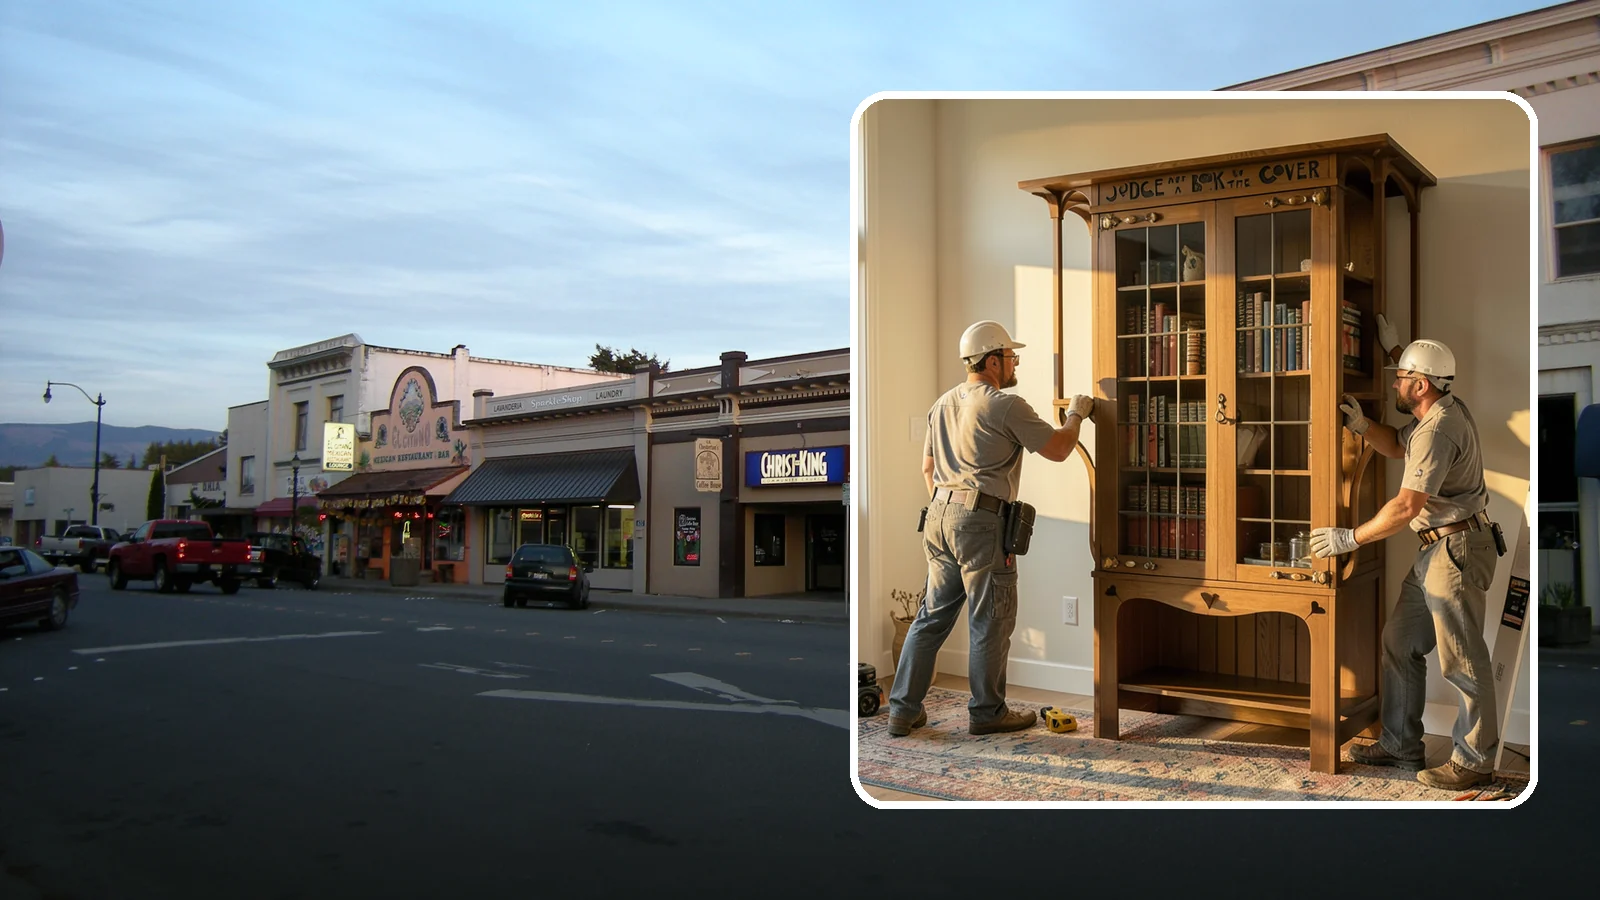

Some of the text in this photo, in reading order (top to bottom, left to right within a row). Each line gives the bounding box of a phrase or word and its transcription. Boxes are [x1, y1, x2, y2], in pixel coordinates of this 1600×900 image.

[1259, 160, 1320, 184] COVER
[1106, 179, 1164, 202] JUDGE
[531, 394, 582, 409] Sparkle Shop
[595, 389, 623, 400] LAUNDRY
[494, 402, 522, 412] LAVANDERIA
[374, 450, 450, 463] MEXICAN RESTAURANT BAR
[761, 450, 828, 477] CHRIST KING
[710, 481, 722, 489] House
